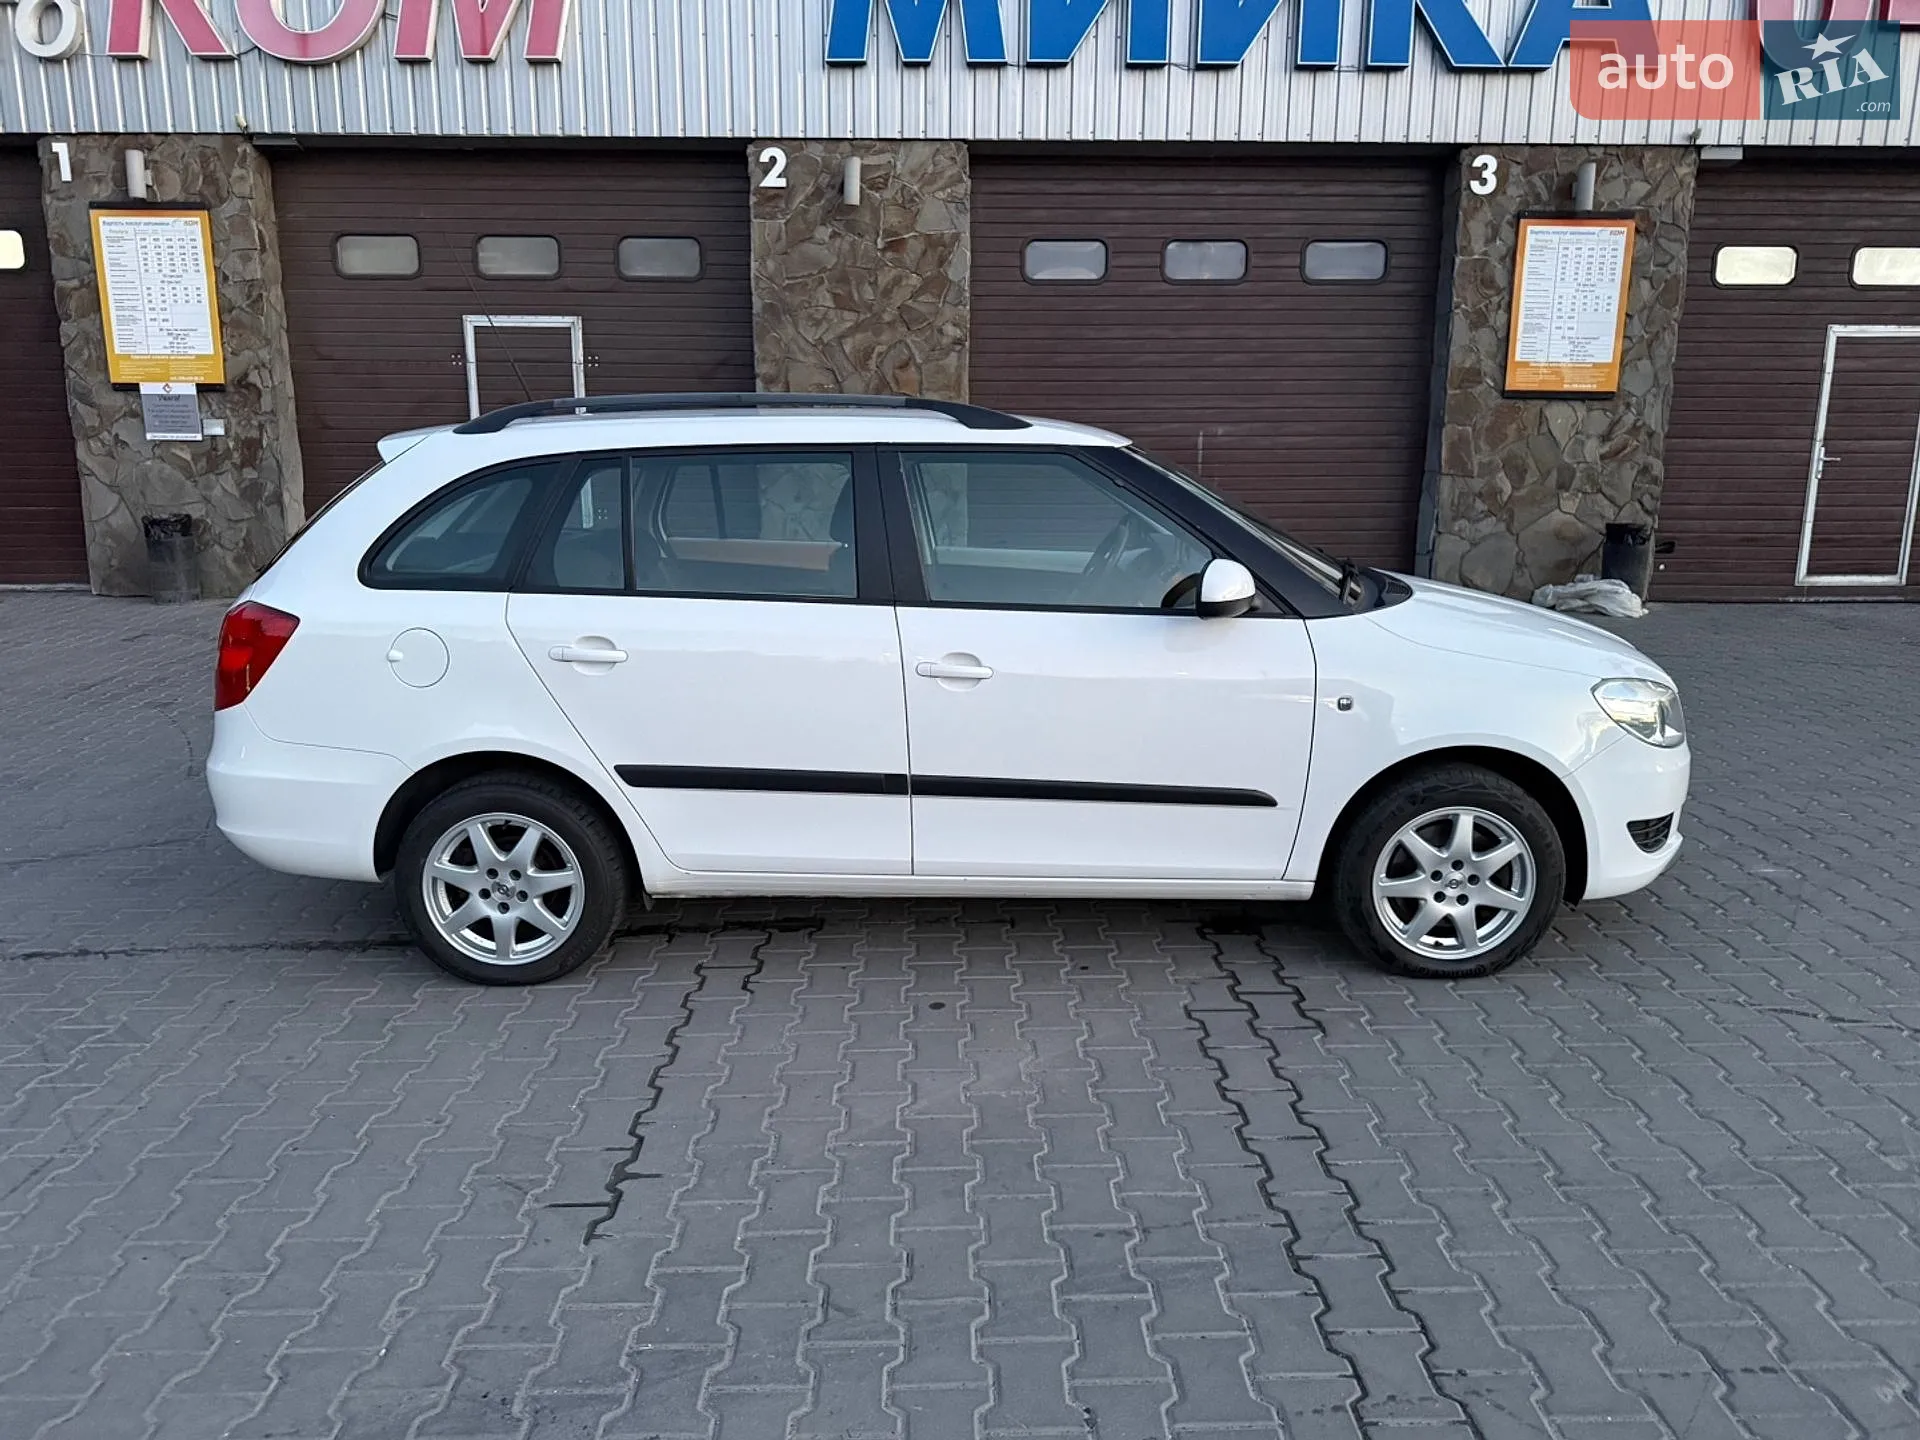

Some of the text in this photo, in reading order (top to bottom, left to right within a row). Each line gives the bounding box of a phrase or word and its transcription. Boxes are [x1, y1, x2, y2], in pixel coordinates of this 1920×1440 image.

[51, 142, 72, 181] 1
[759, 146, 787, 188] 2
[1470, 154, 1498, 195] 3
